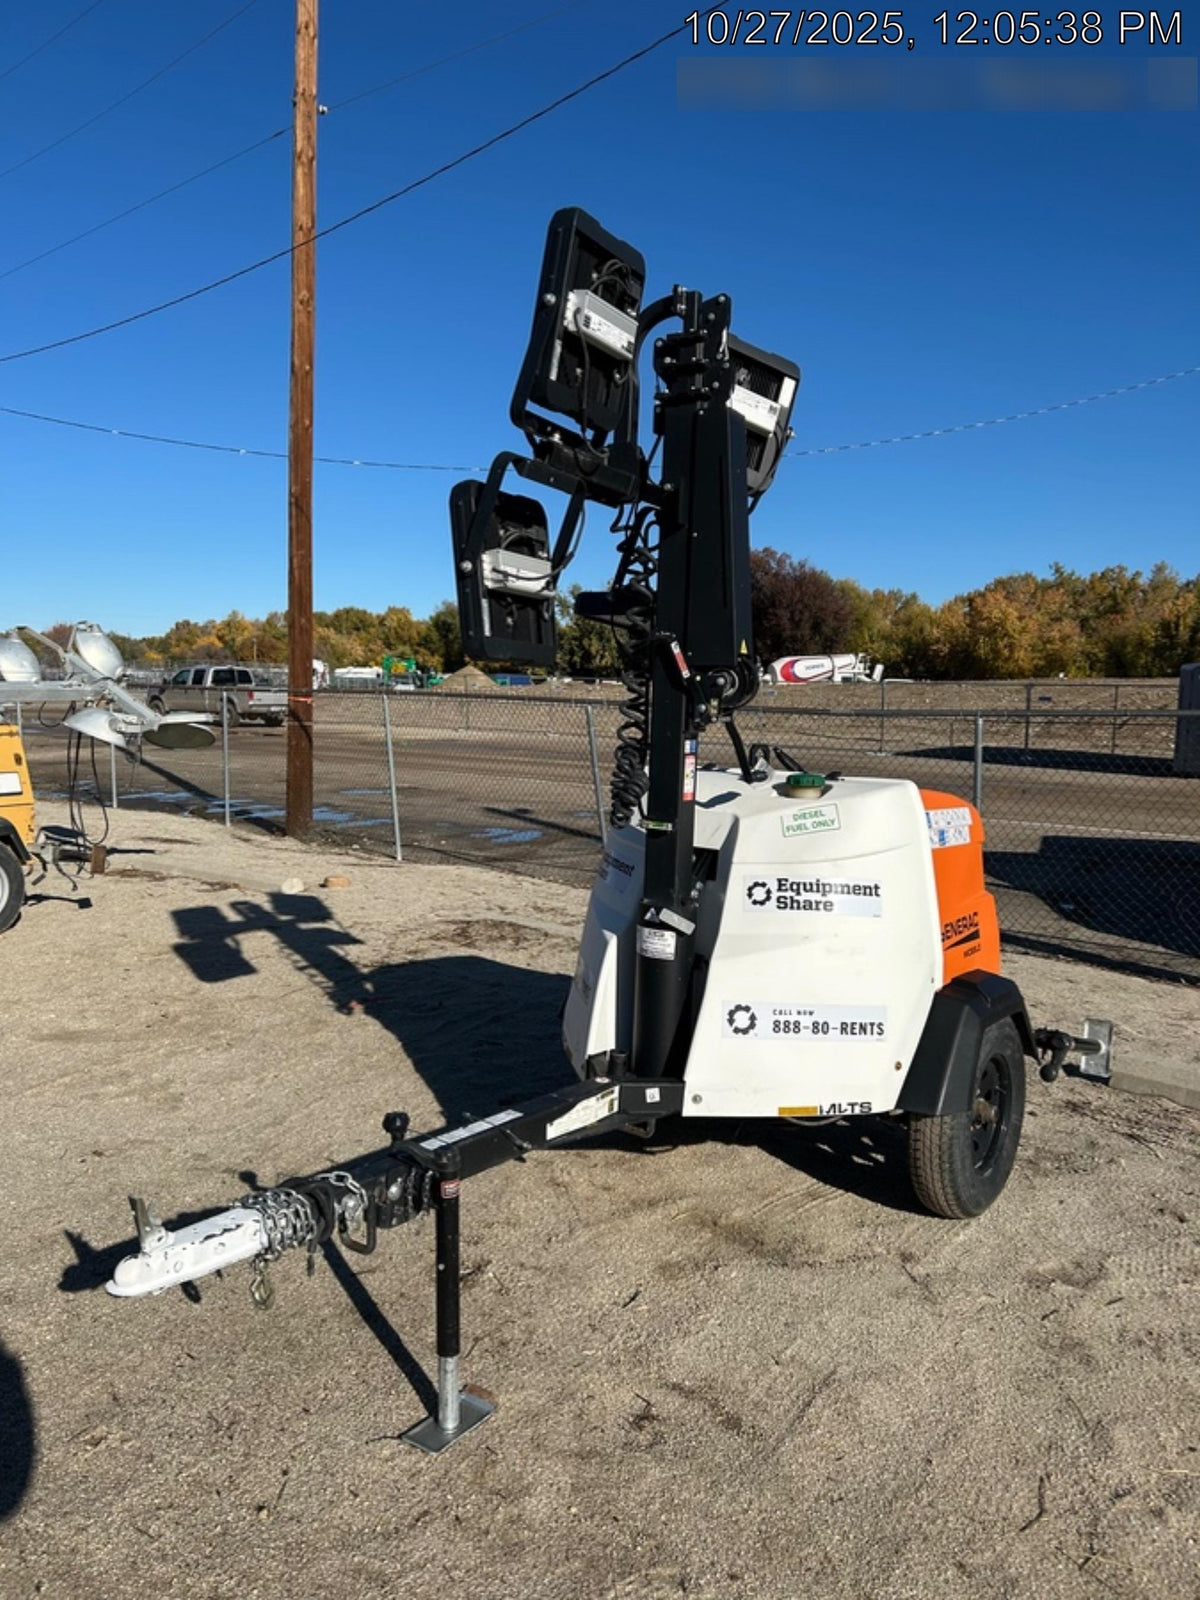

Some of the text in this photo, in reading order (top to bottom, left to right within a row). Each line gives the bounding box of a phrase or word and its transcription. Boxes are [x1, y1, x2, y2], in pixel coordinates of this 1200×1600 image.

[793, 810, 826, 821] DIESEL
[785, 817, 836, 832] FUEL ONLY
[776, 878, 881, 897] Equipment
[776, 895, 834, 912] Share
[772, 1019, 885, 1036] 888-80-RENTS
